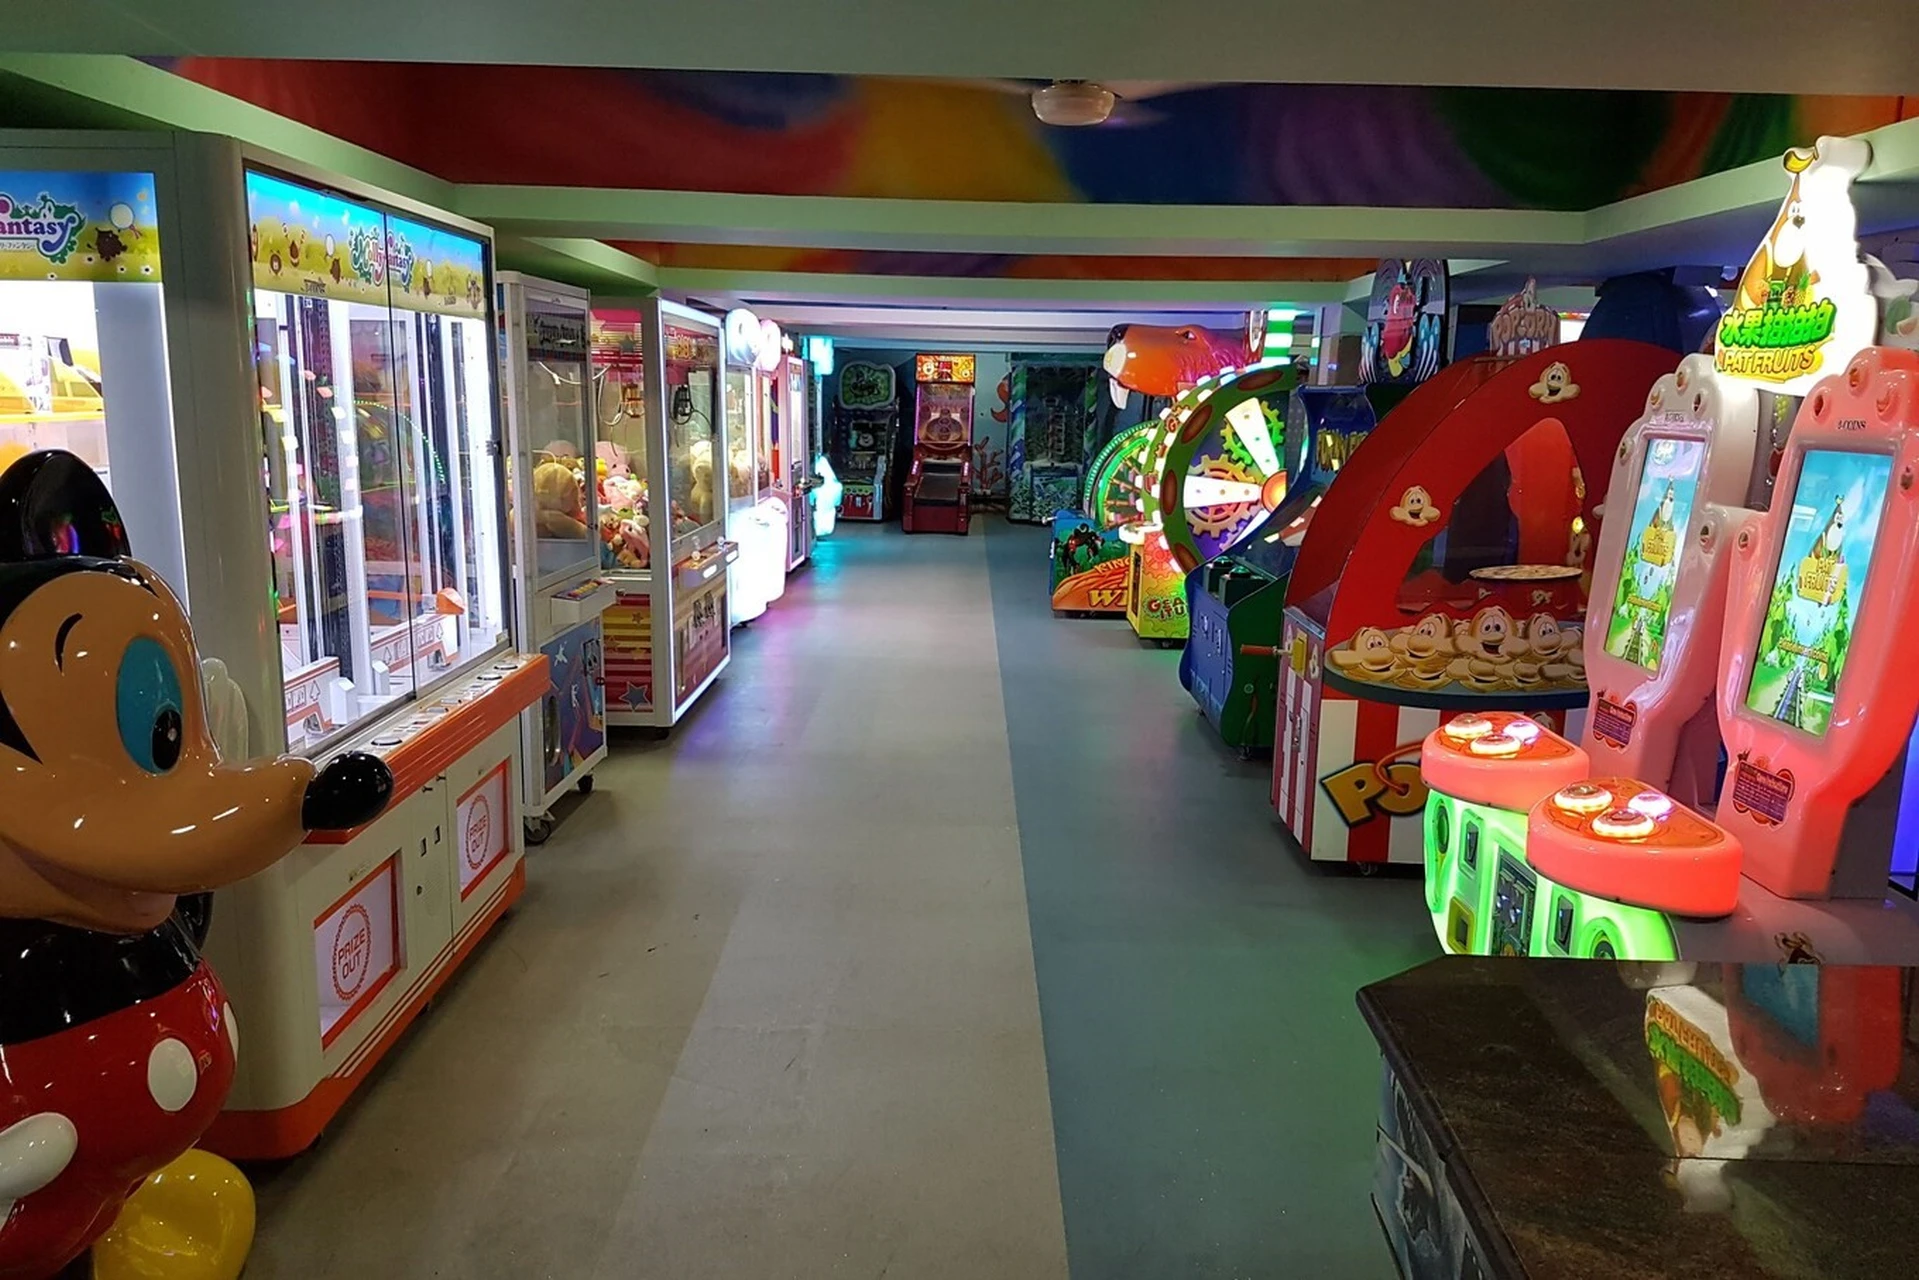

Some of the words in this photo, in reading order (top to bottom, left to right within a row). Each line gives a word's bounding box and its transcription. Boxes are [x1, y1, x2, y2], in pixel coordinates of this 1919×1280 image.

[0, 214, 77, 253] antasy
[1723, 350, 1752, 374] PAT
[1751, 345, 1817, 374] FRUITS
[337, 928, 366, 965] PRIZE
[342, 949, 361, 979] OUT
